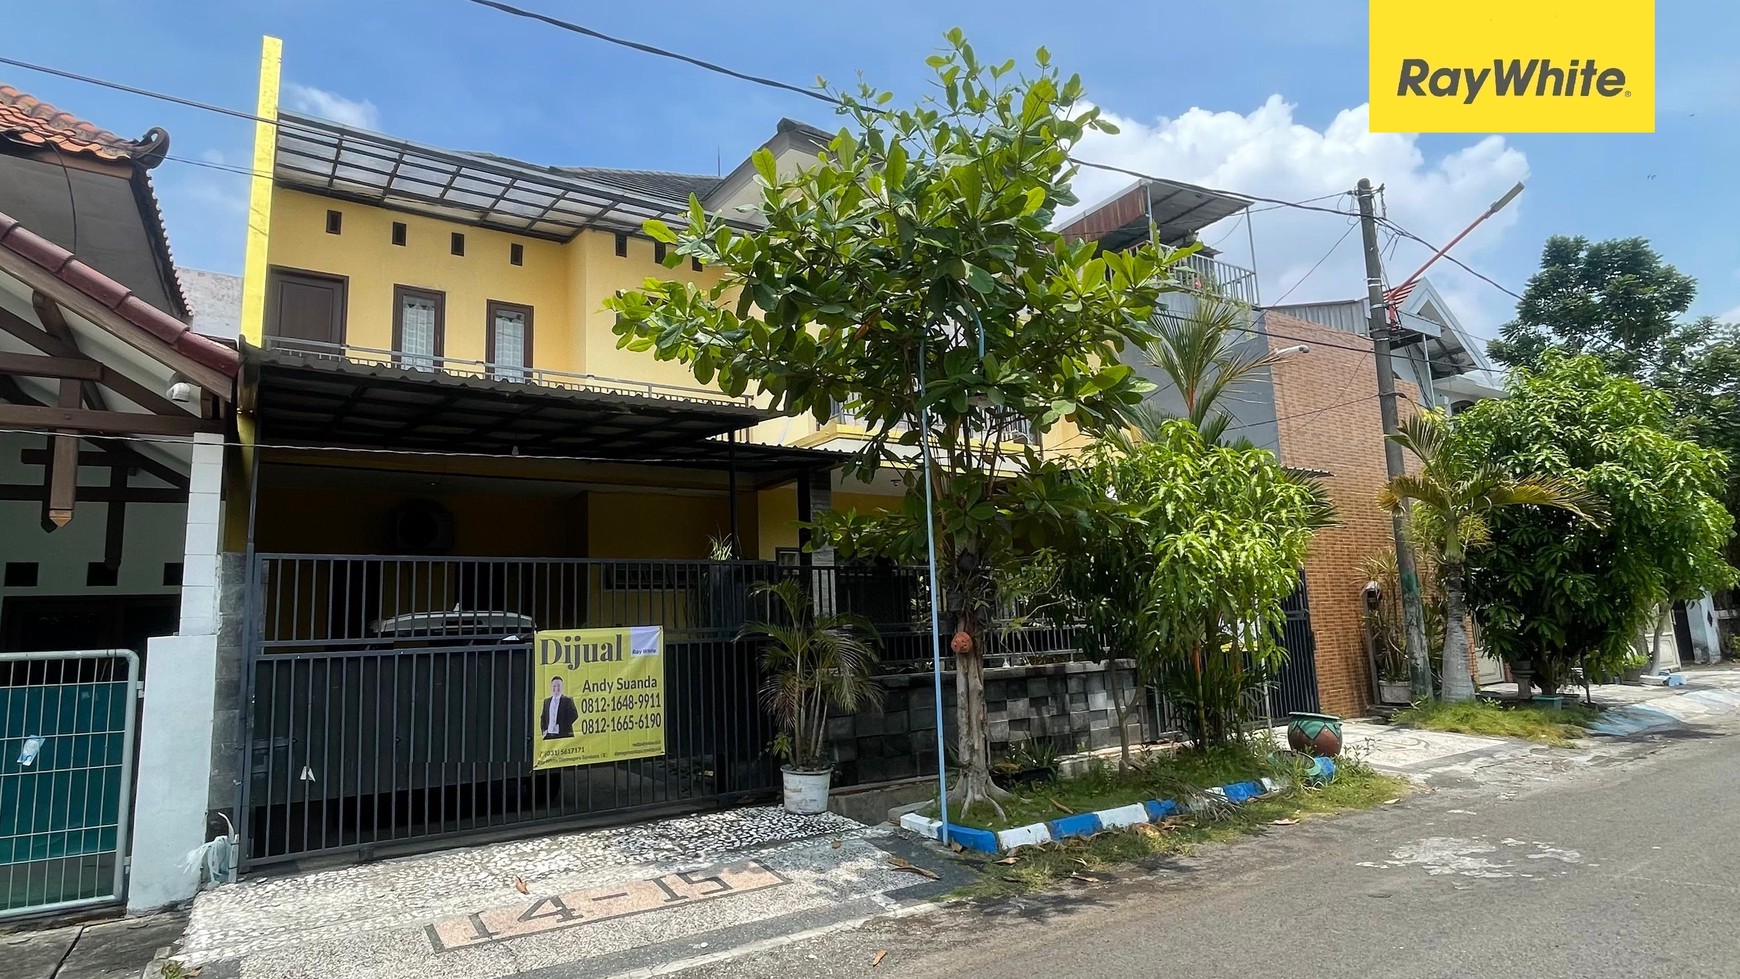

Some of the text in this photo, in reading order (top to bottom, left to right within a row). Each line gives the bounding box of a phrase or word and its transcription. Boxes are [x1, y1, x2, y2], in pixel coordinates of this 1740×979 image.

[540, 634, 623, 670] Dijual
[582, 675, 657, 693] Andy Suanda
[581, 693, 661, 714] 0812-1648-9911
[582, 713, 661, 735] 0812-1665-6190
